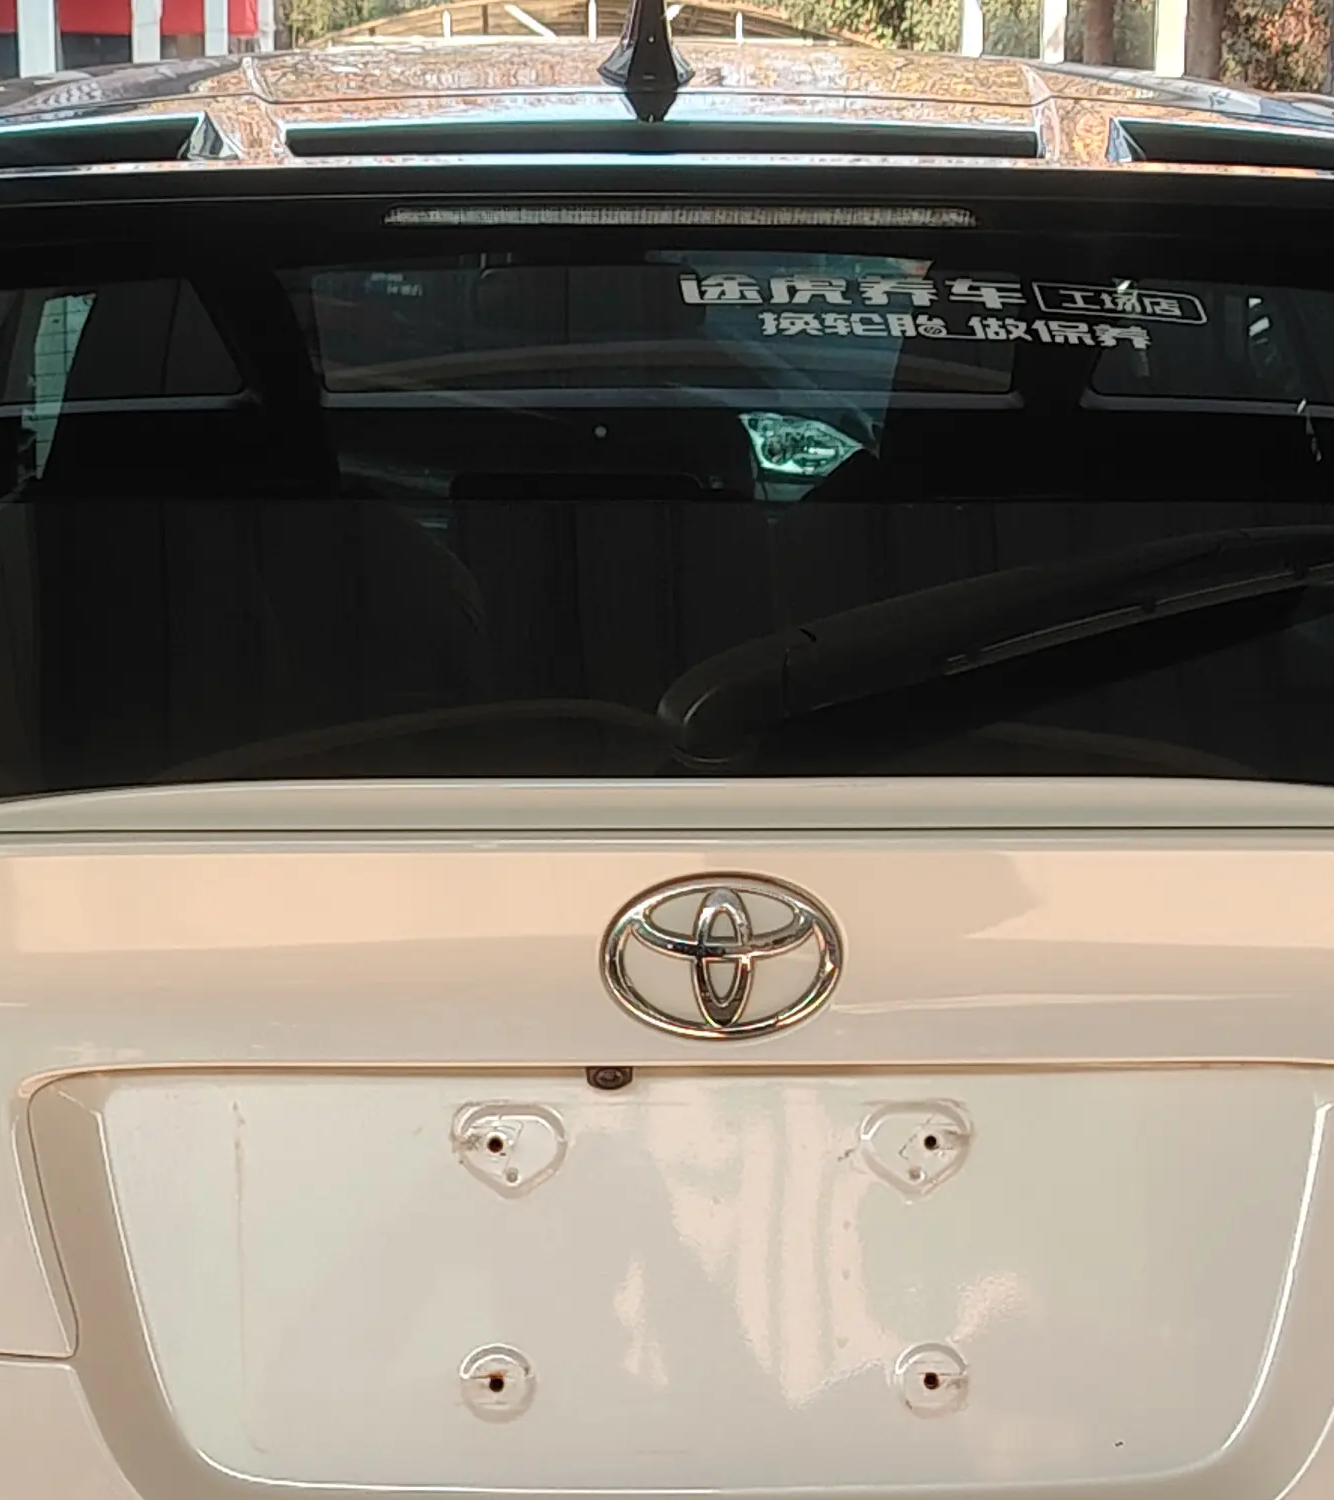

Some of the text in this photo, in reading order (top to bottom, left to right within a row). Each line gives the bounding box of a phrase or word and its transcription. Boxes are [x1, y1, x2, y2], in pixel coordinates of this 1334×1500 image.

[679, 273, 1027, 310] 途虎养车
[758, 311, 948, 338] 换轮胎
